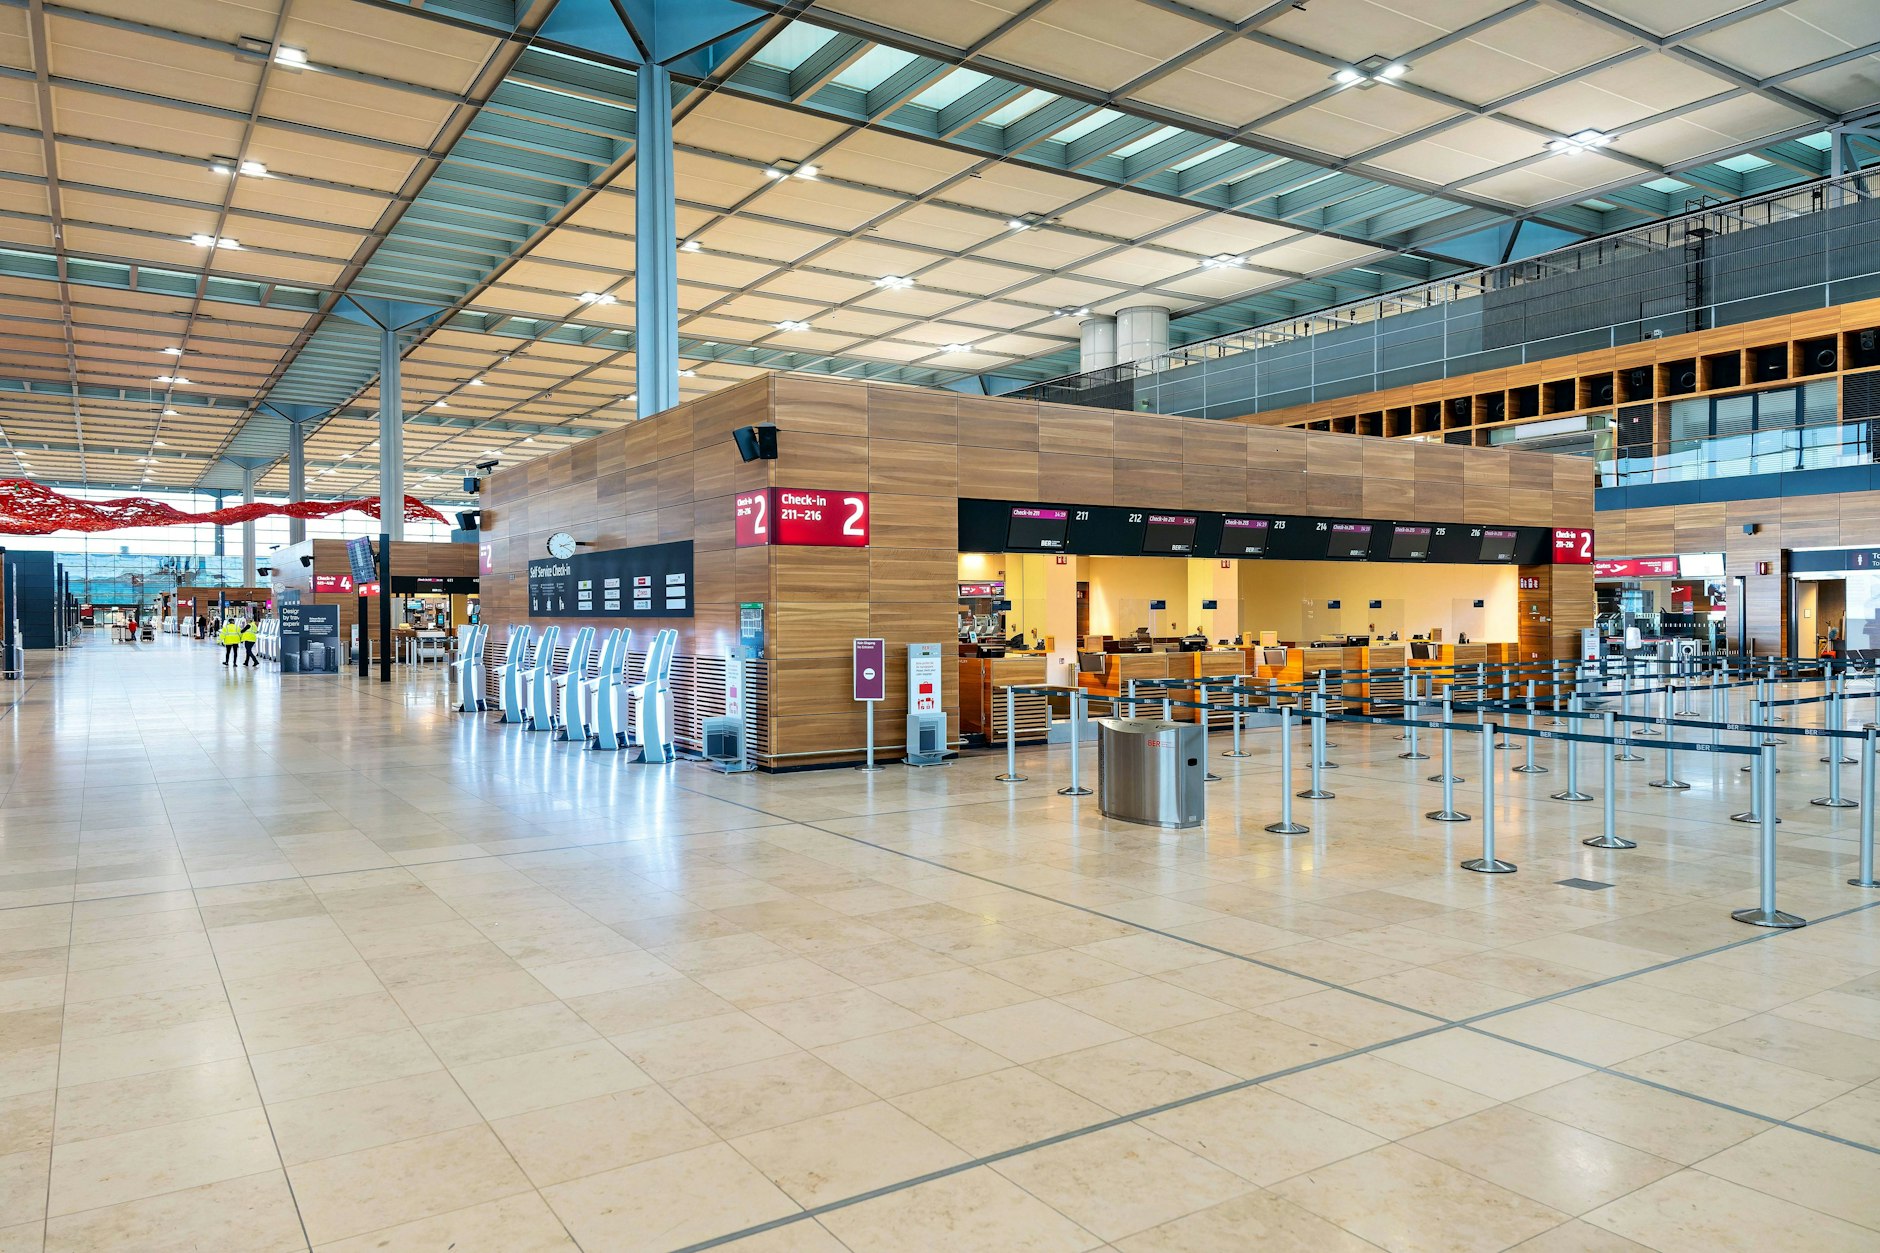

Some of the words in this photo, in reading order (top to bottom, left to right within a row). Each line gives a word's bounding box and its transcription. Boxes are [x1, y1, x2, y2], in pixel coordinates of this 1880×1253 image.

[781, 494, 826, 506] Check-in
[754, 494, 766, 534] 2
[781, 509, 822, 520] 211–216
[842, 497, 864, 536] 2
[1076, 511, 1089, 520] 211
[1128, 514, 1142, 522] 212
[1274, 521, 1286, 529] 213
[1580, 532, 1591, 557] 2
[486, 545, 491, 568] 2
[538, 565, 552, 578] Service
[552, 563, 571, 576] Check-in
[340, 577, 351, 590] 4
